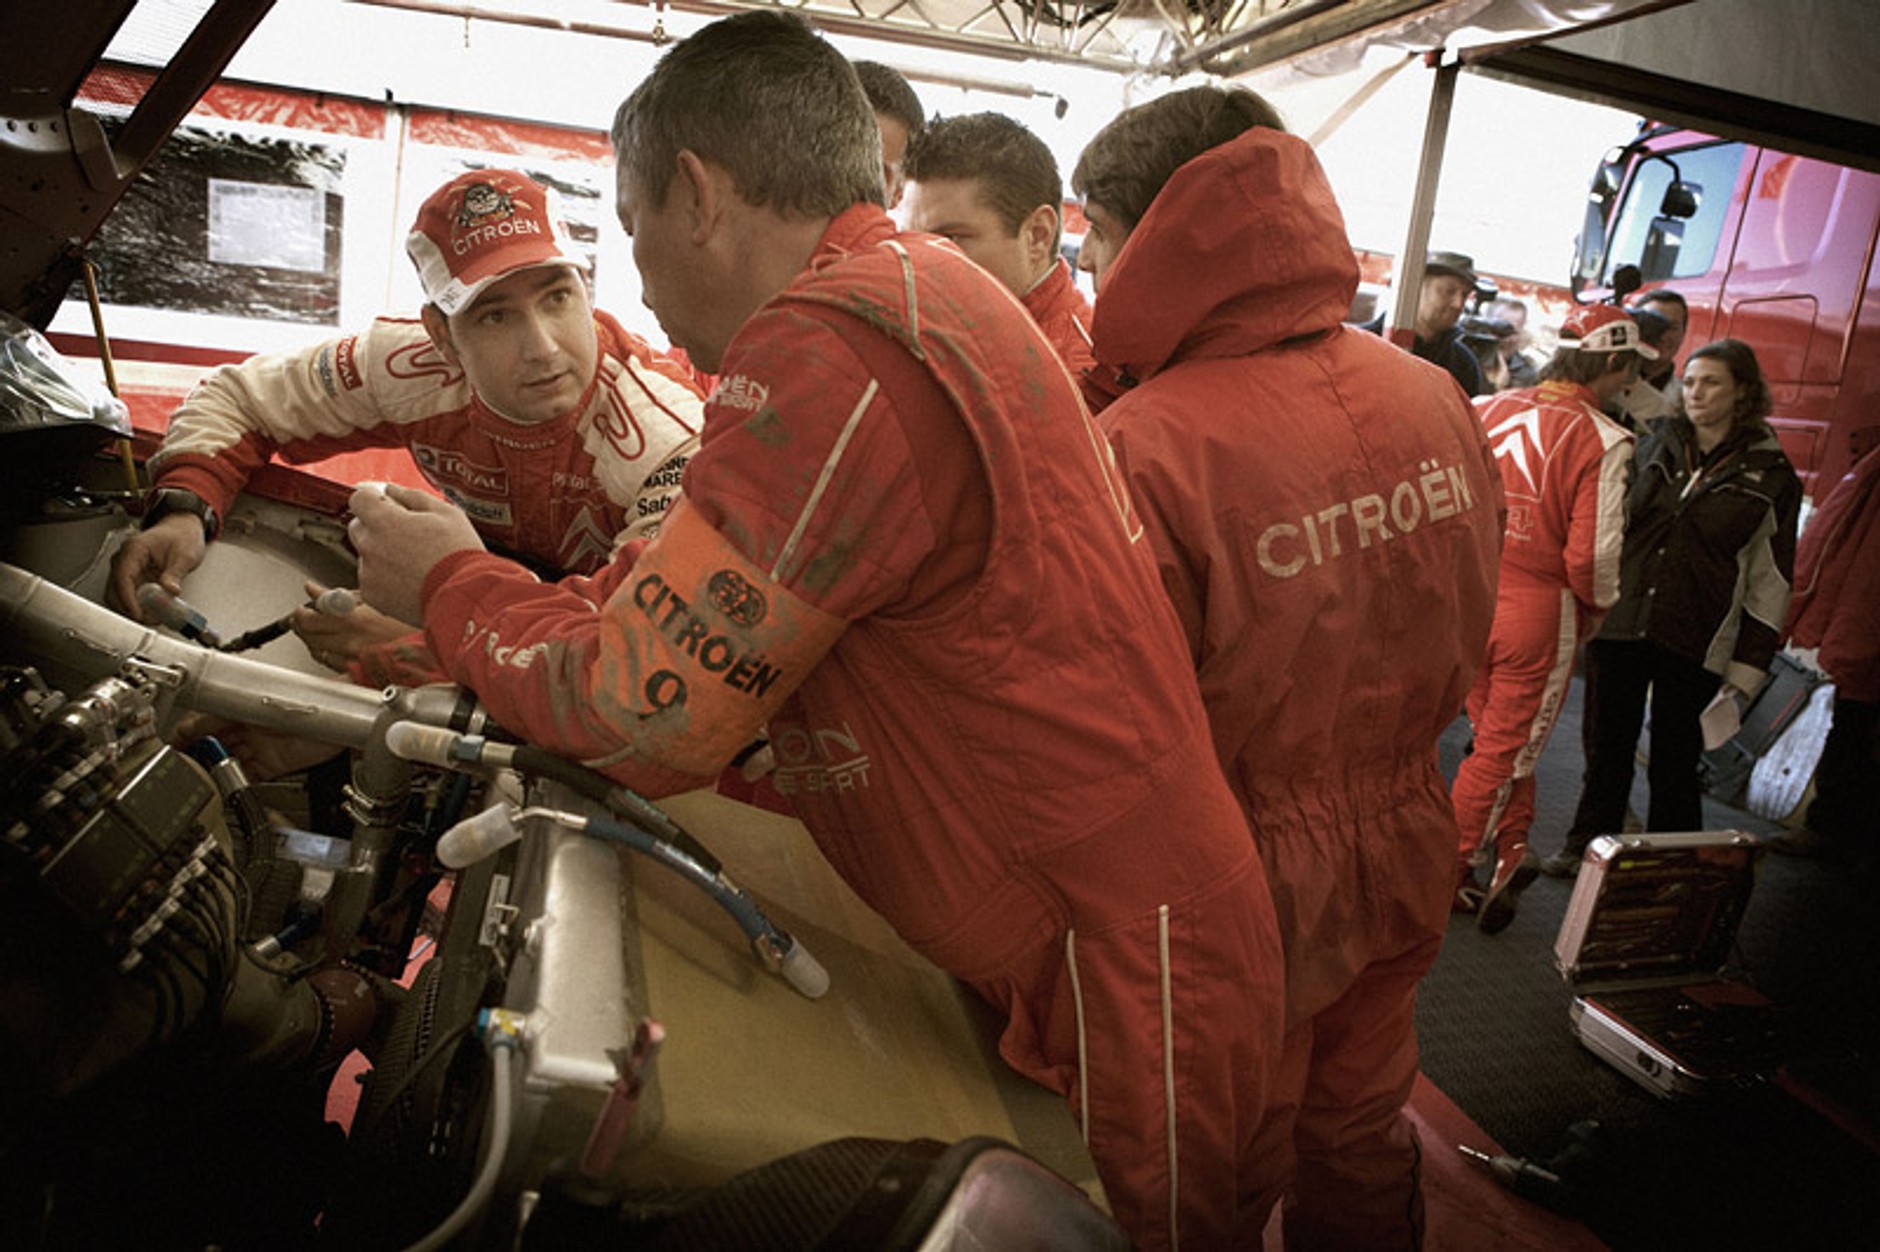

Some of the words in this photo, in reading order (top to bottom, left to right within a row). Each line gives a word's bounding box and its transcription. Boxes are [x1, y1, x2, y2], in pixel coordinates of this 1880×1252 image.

[452, 216, 541, 256] CITROËN
[440, 455, 504, 490] TOTAL
[1256, 458, 1473, 578] CITROËN
[634, 573, 782, 699] CITROËN
[637, 669, 687, 720] 9
